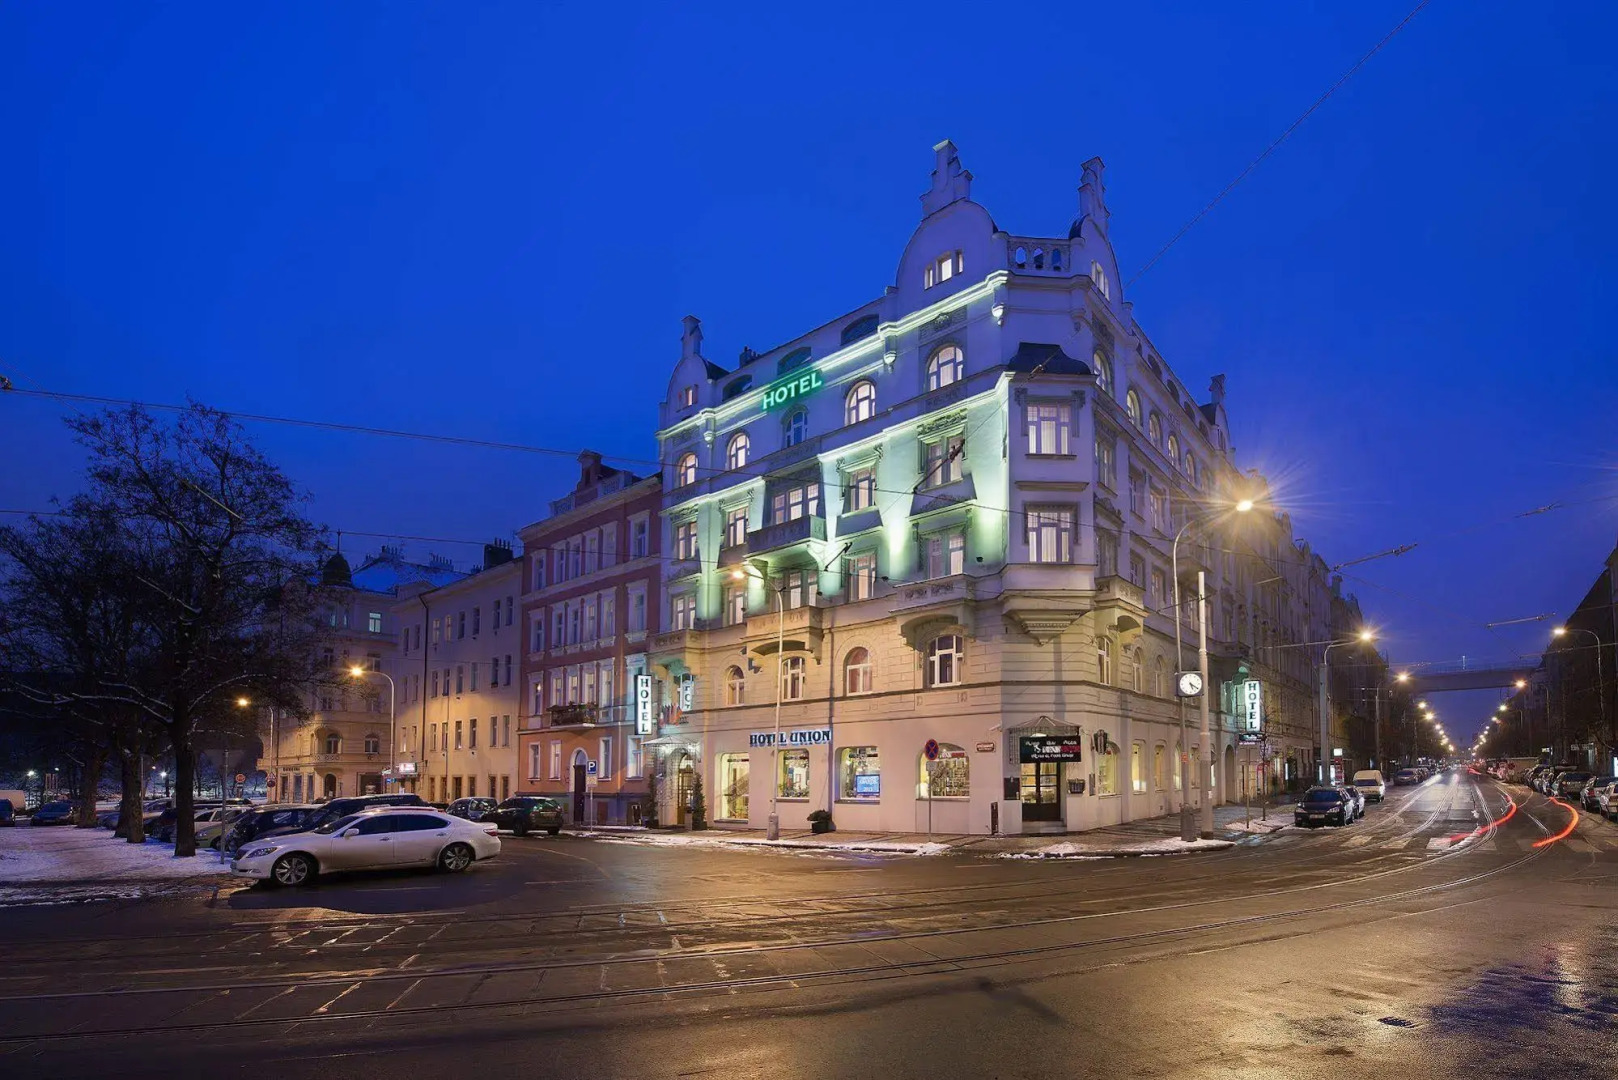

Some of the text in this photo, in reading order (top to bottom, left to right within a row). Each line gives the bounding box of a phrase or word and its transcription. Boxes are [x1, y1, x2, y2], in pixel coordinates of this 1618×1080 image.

[763, 372, 822, 410] HOTEL
[640, 678, 649, 732] HOTEL
[1248, 682, 1257, 729] HOTEL
[789, 730, 830, 743] UNION
